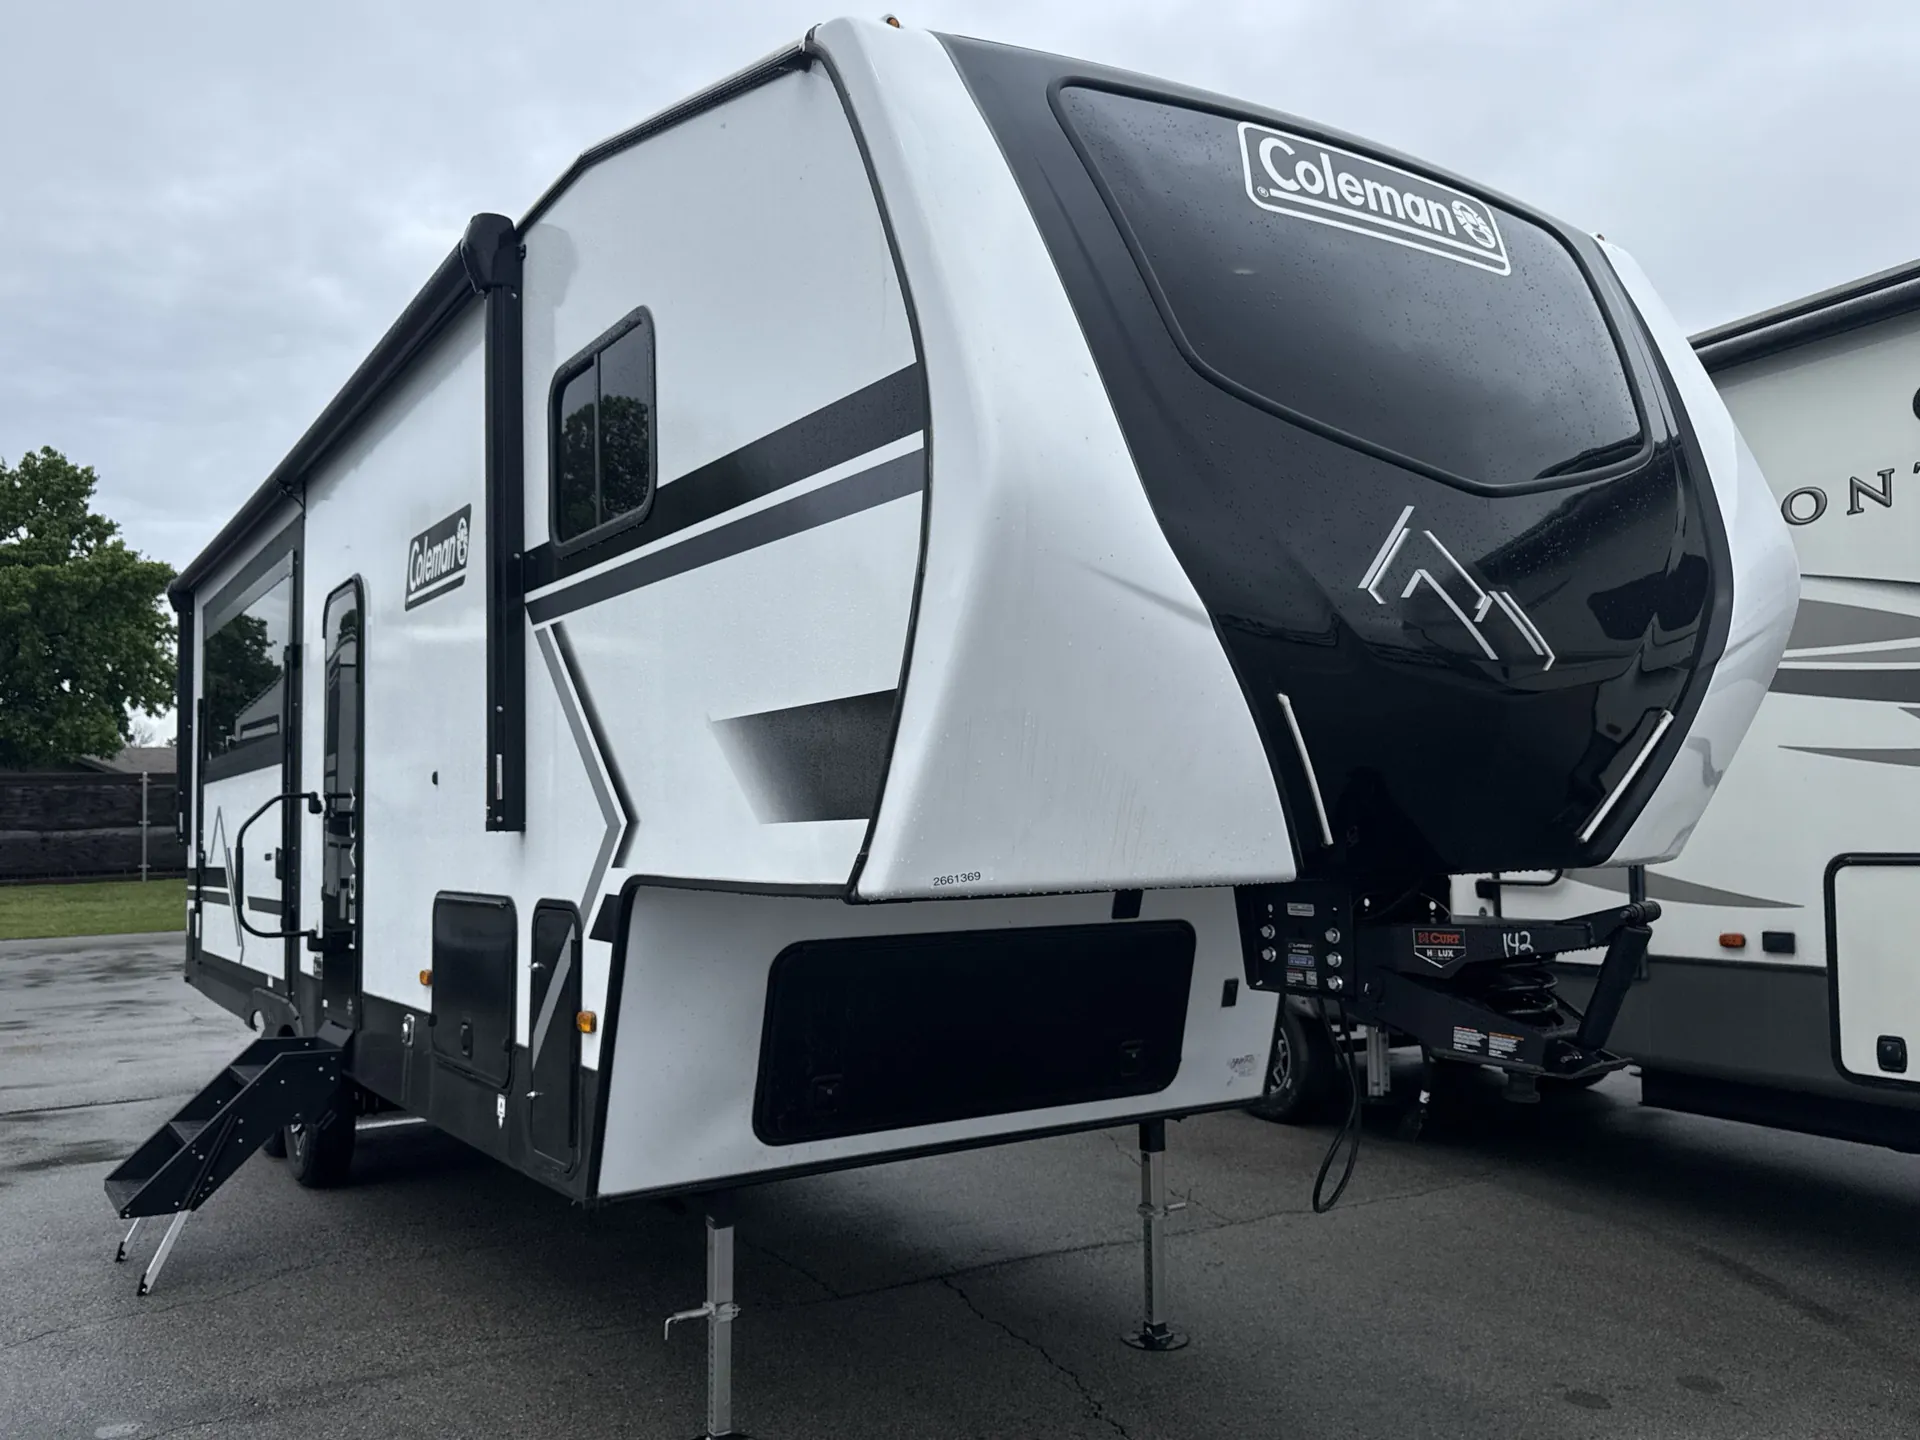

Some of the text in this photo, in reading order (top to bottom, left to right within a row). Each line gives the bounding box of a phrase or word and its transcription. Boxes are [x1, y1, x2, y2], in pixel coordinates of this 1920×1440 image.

[1259, 137, 1456, 235] Coleman
[1781, 461, 1920, 526] ON
[409, 535, 456, 592] Coleman
[933, 871, 981, 886] 2661369
[1430, 932, 1460, 944] CURT
[1503, 931, 1533, 958] 142
